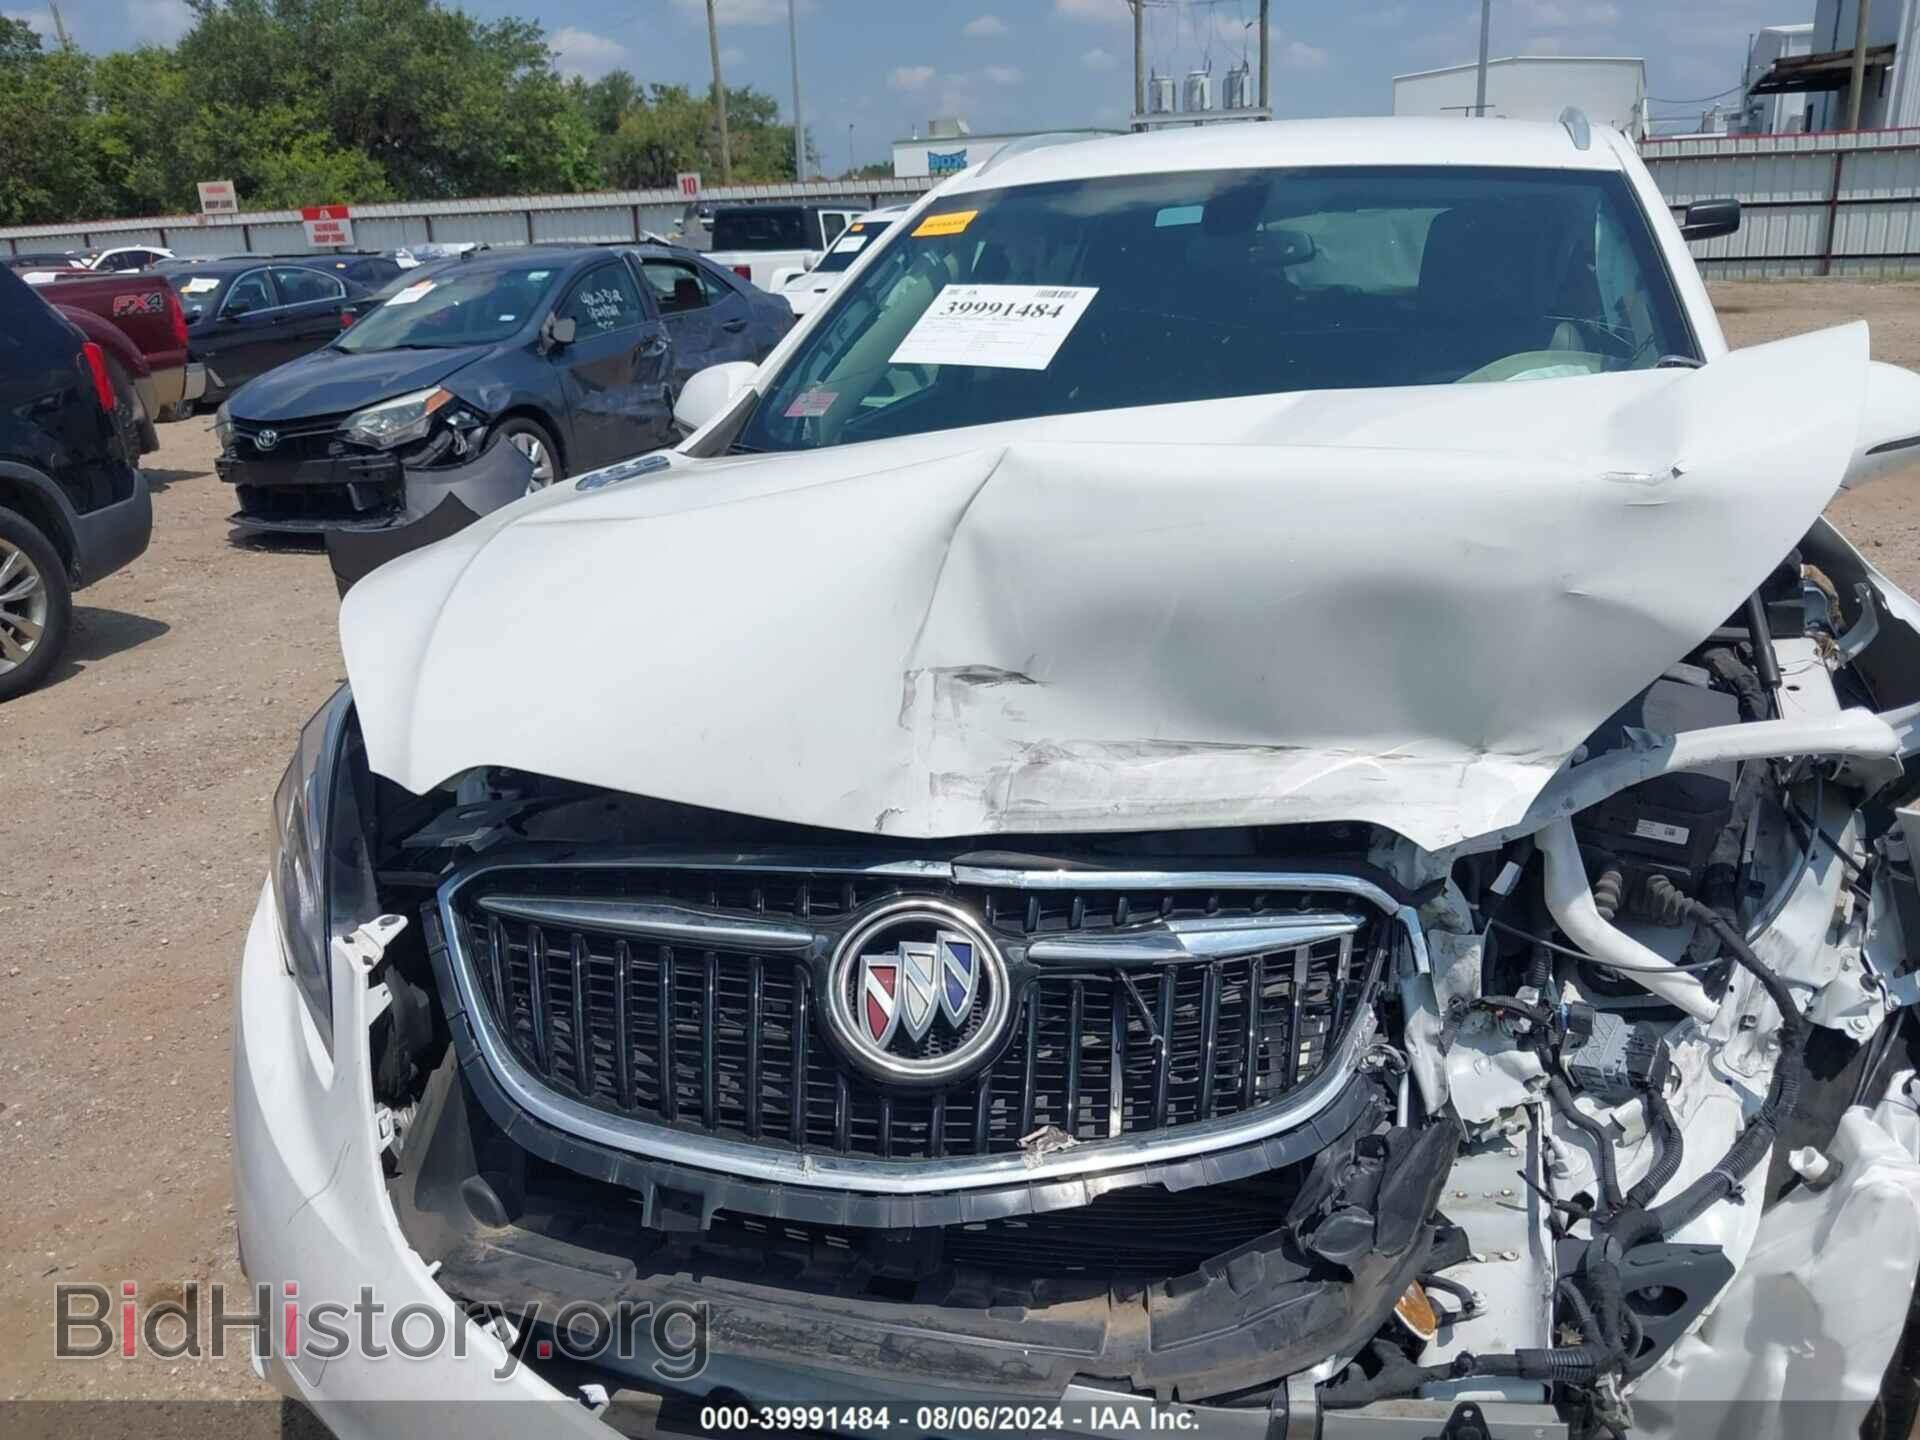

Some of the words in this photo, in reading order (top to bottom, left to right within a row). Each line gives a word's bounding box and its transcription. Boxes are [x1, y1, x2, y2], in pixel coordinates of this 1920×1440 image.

[682, 177, 697, 195] 10
[113, 292, 163, 313] FX4
[939, 301, 1065, 318] 39991484
